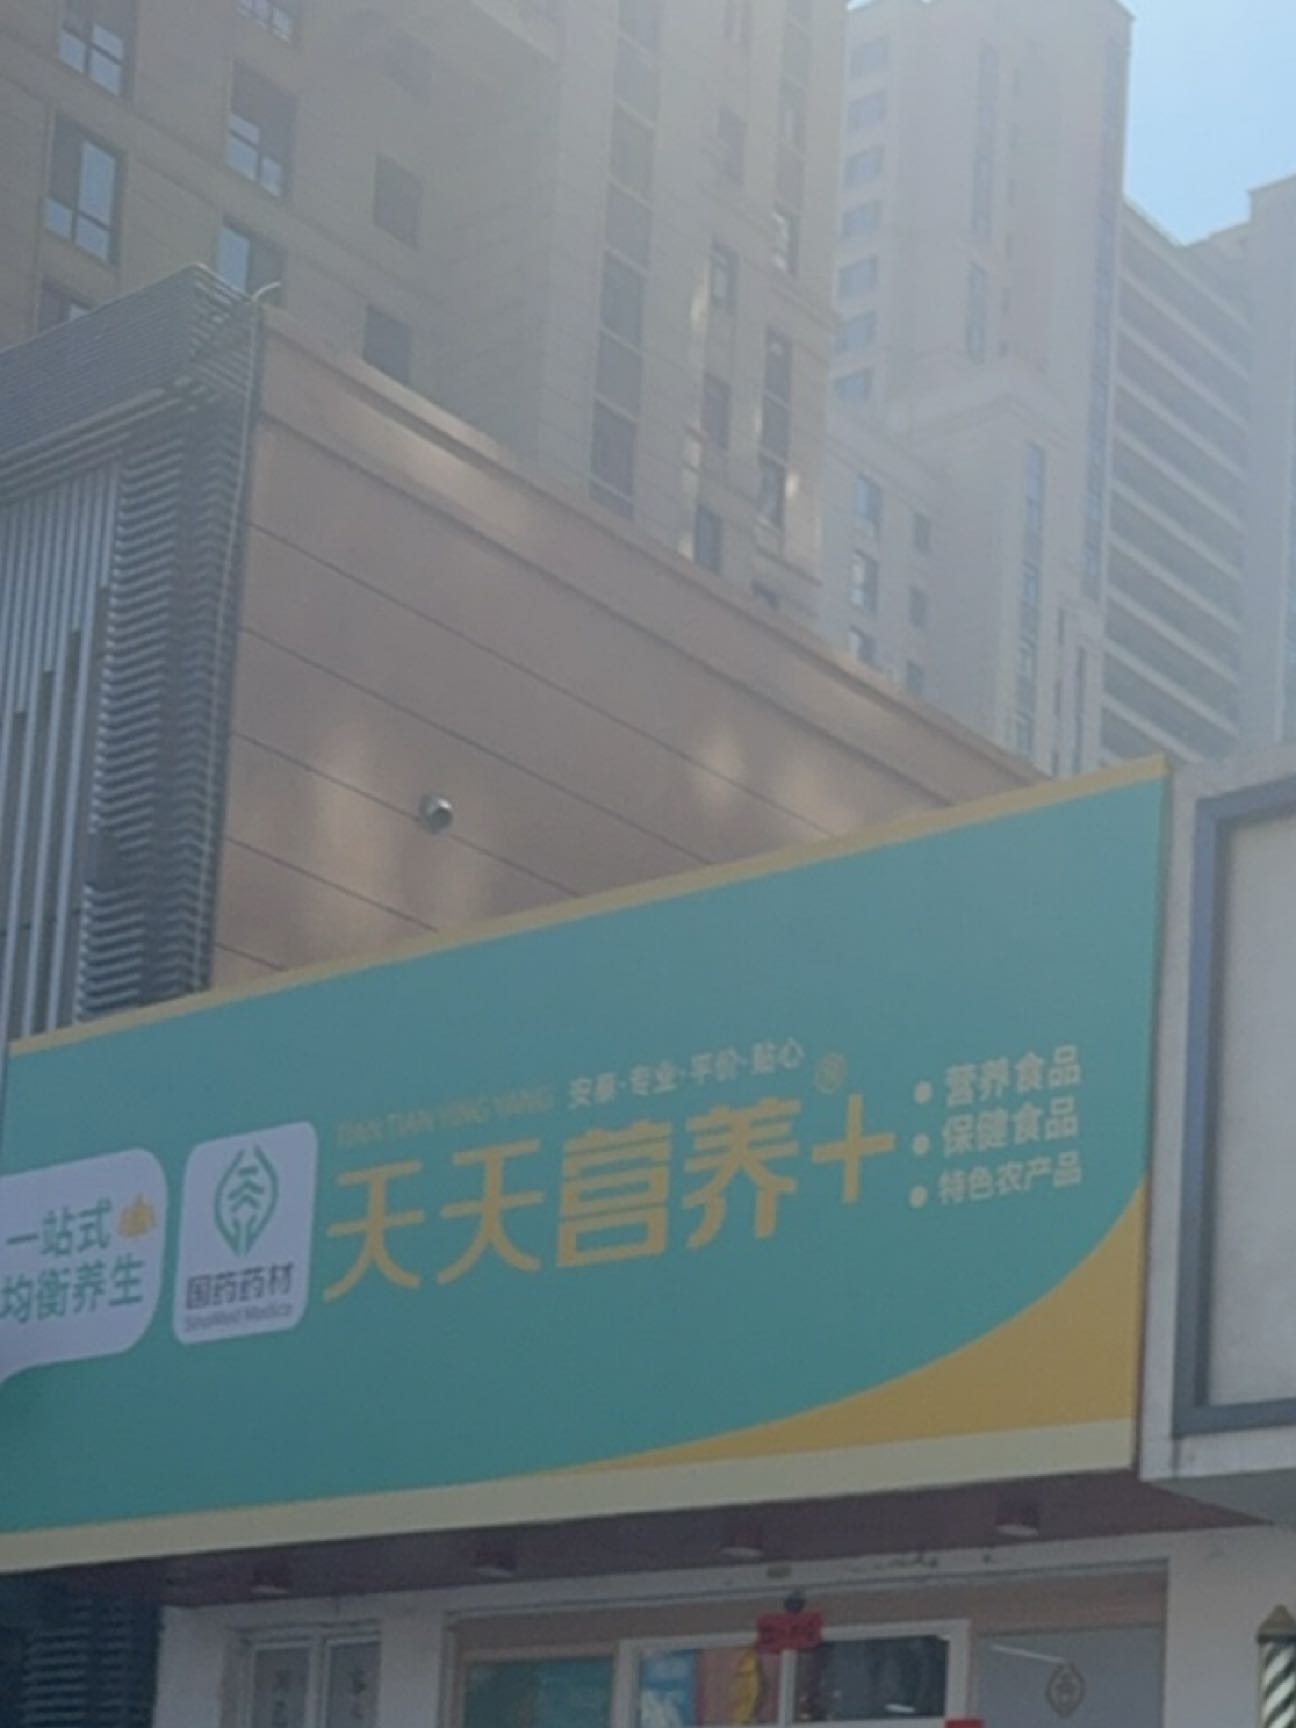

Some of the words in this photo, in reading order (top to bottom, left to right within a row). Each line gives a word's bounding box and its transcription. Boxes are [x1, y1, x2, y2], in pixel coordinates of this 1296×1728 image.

[944, 1044, 1081, 1106] 营养食品
[943, 1096, 1079, 1158] 保健食品
[938, 1151, 1083, 1206] 特色农产品
[6, 1198, 111, 1256] 一站式
[0, 1252, 145, 1324] 均衡养生
[186, 1261, 295, 1311] 国药药材
